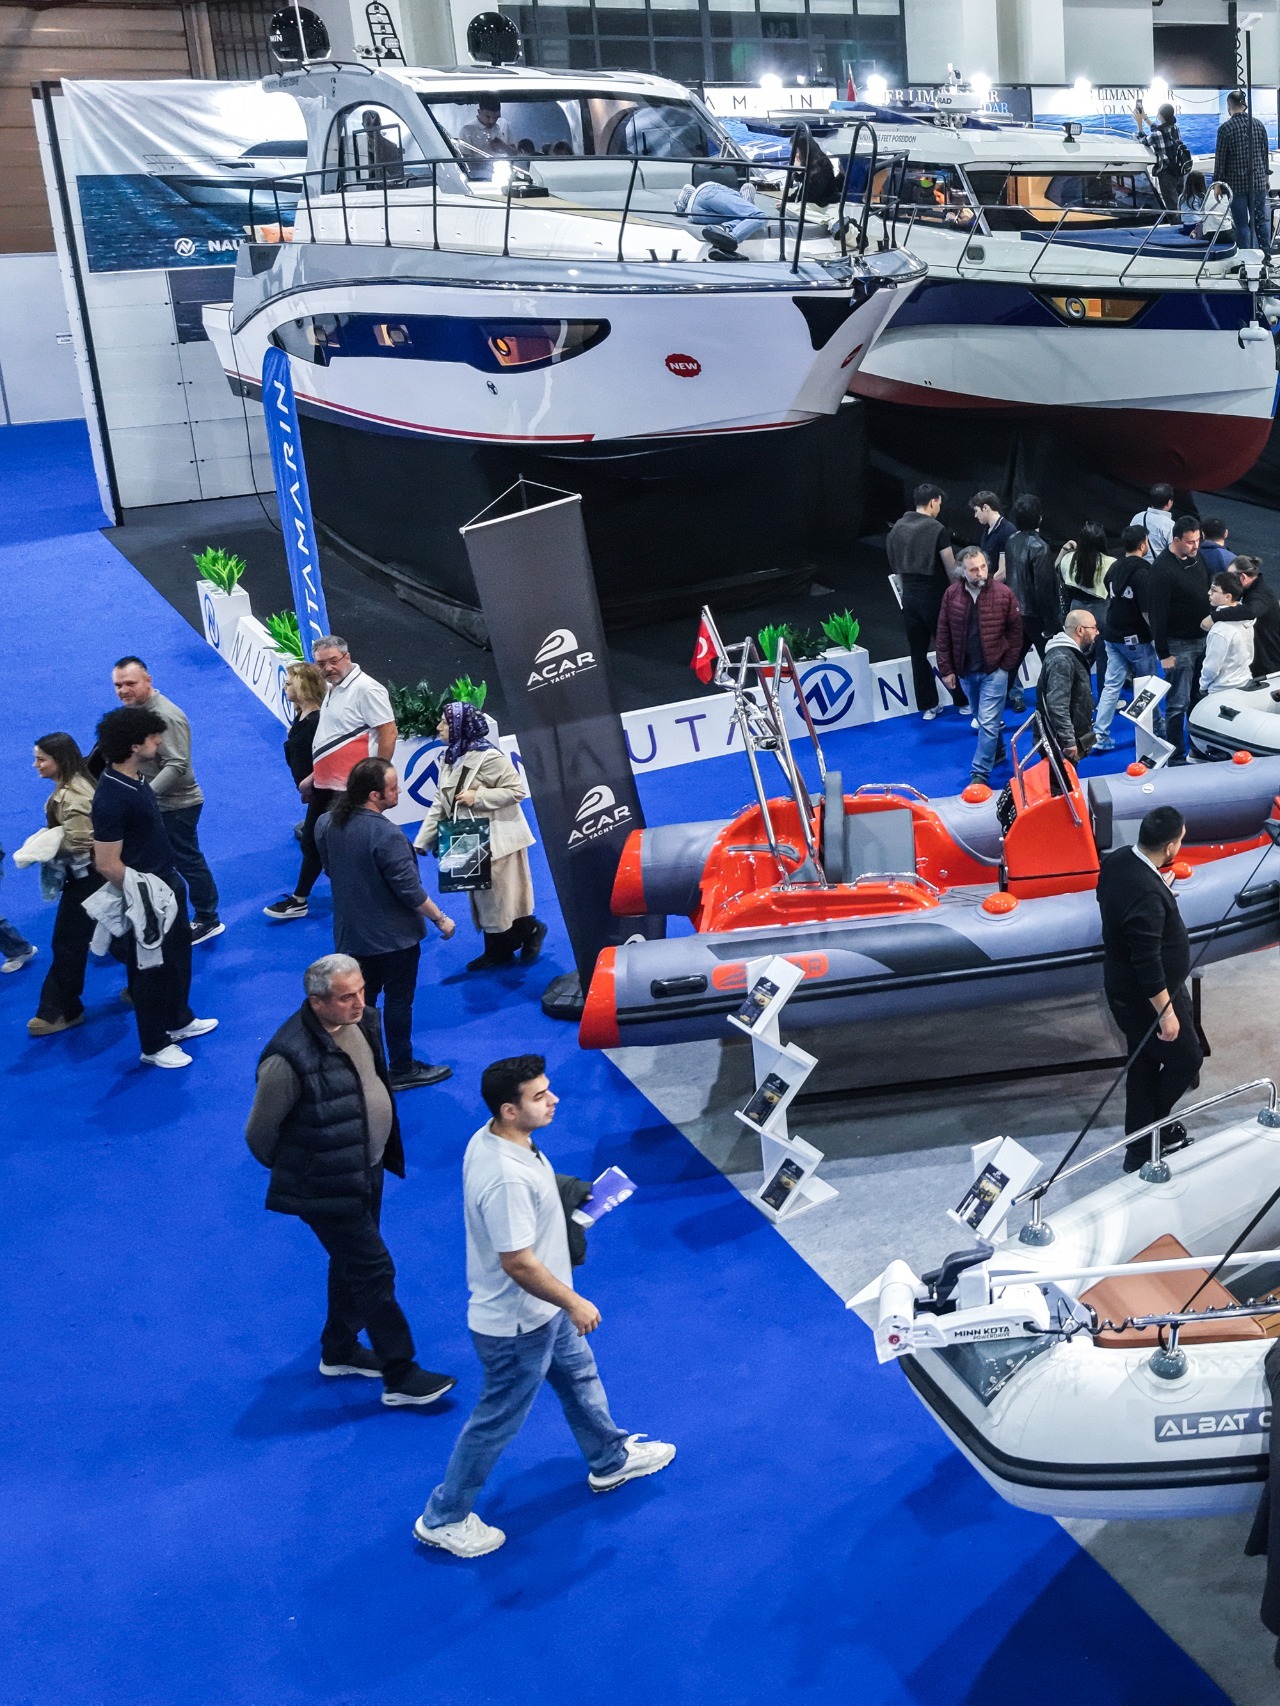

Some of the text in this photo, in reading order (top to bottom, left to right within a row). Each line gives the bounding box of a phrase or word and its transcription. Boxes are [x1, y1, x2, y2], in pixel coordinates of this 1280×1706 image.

[733, 94, 812, 109] MIN
[208, 239, 247, 253] NAU
[669, 361, 698, 371] NEW
[231, 631, 277, 703] NAUT
[526, 651, 596, 686] ACAR
[550, 670, 576, 684] YACHT
[567, 805, 631, 844] ACAR
[589, 825, 614, 840] YACHT
[954, 1326, 1010, 1338] MINN KOTA
[973, 1332, 1010, 1340] POWERDRIVE
[1158, 1413, 1250, 1437] ALBAT
